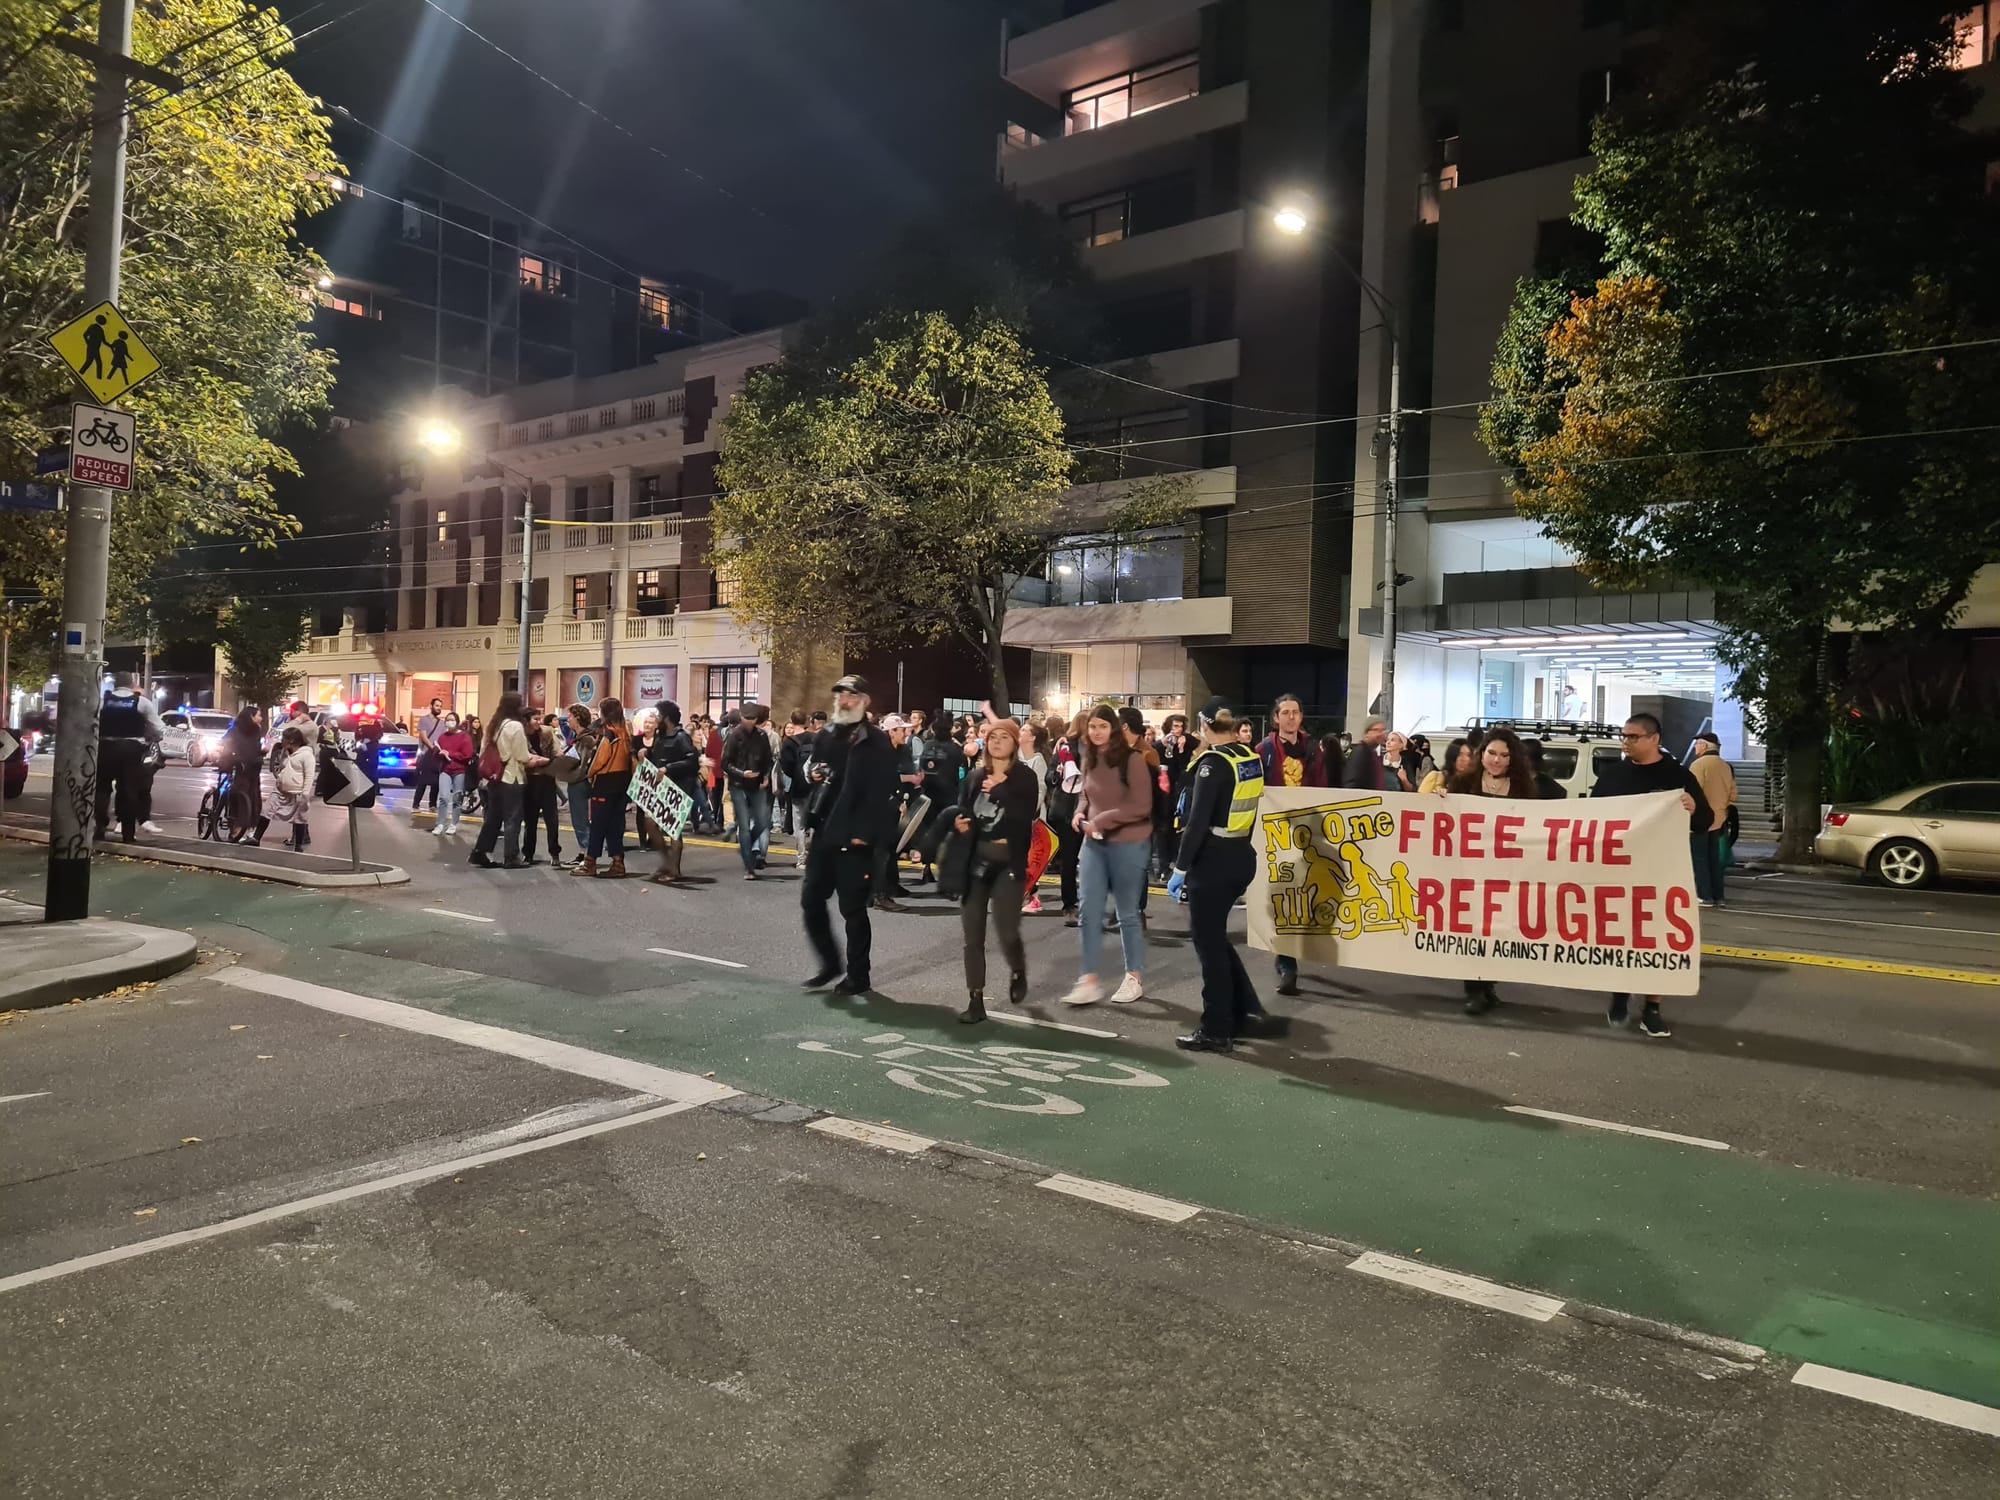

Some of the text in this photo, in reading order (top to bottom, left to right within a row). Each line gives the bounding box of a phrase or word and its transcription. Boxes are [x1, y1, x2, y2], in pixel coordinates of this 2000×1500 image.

[77, 457, 127, 475] REDUCE
[81, 468, 121, 484] SPEED
[636, 785, 681, 835] FREEDOM!
[665, 786, 683, 812] FOR
[1263, 811, 1395, 853] No One
[1398, 810, 1632, 866] FREE THE
[1266, 852, 1295, 883] is
[1416, 877, 1695, 952] REFUGEES
[1415, 931, 1487, 958] CAMPAIGN
[1492, 940, 1550, 962] AGAINST
